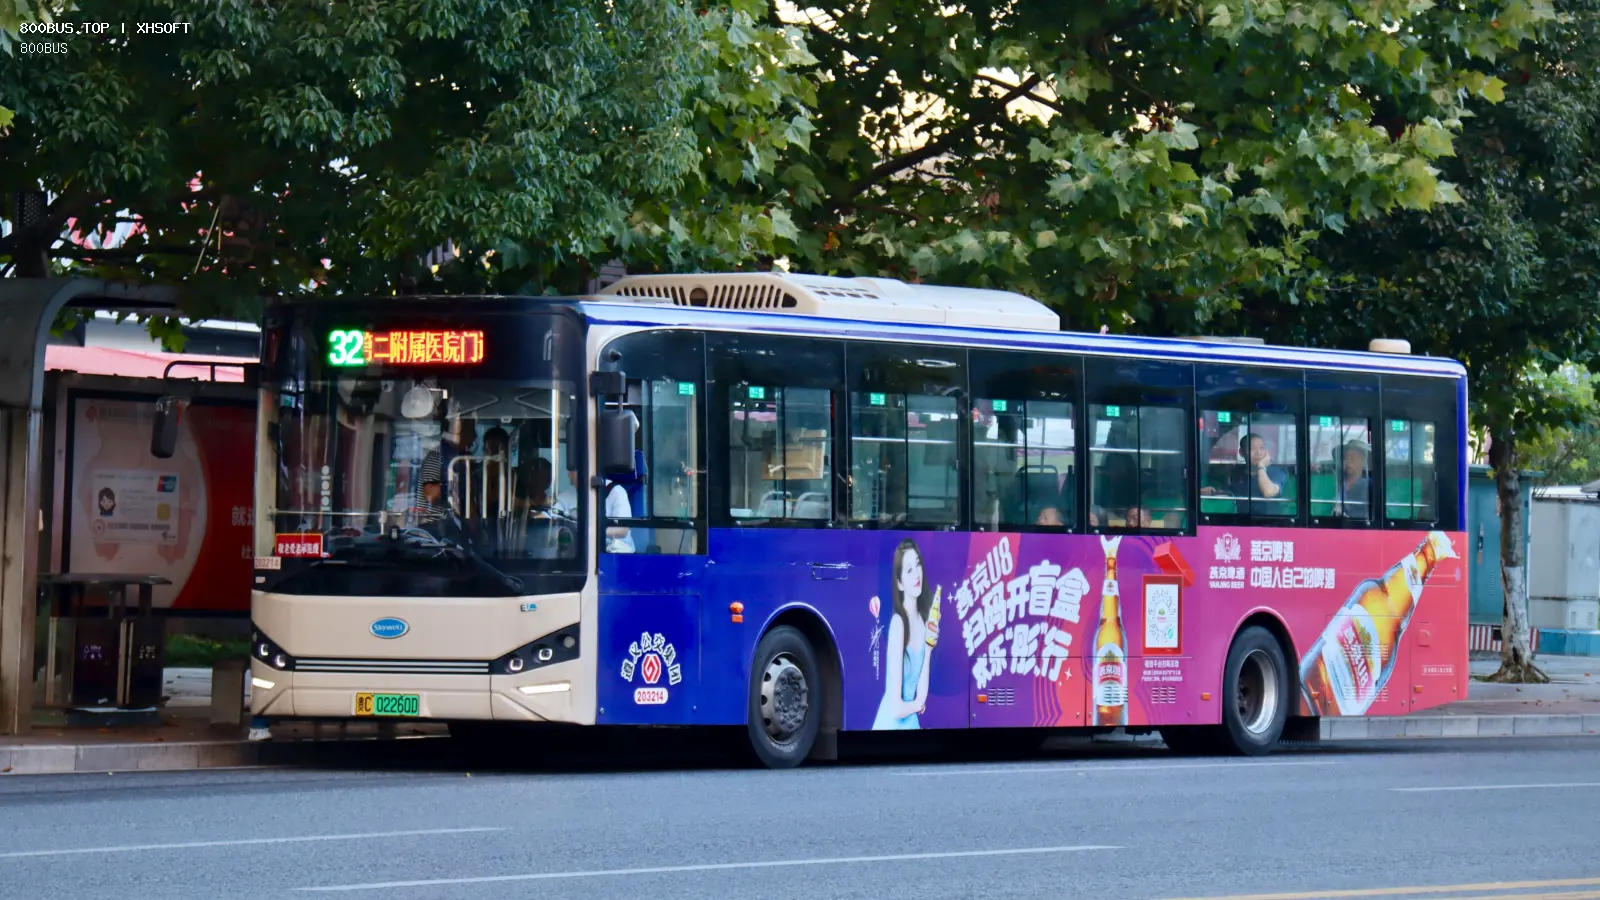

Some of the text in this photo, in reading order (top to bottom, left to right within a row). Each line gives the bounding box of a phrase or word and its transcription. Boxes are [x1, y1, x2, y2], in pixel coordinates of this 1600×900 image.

[329, 330, 364, 364] 32
[1250, 540, 1294, 562] 燕京啤酒
[955, 536, 1013, 620] 燕京U8
[1250, 566, 1336, 589] 中国人自己的啤酒
[962, 559, 1090, 657] 扫码开盲盒
[377, 697, 417, 713] 02260D
[637, 691, 664, 702] 203214
